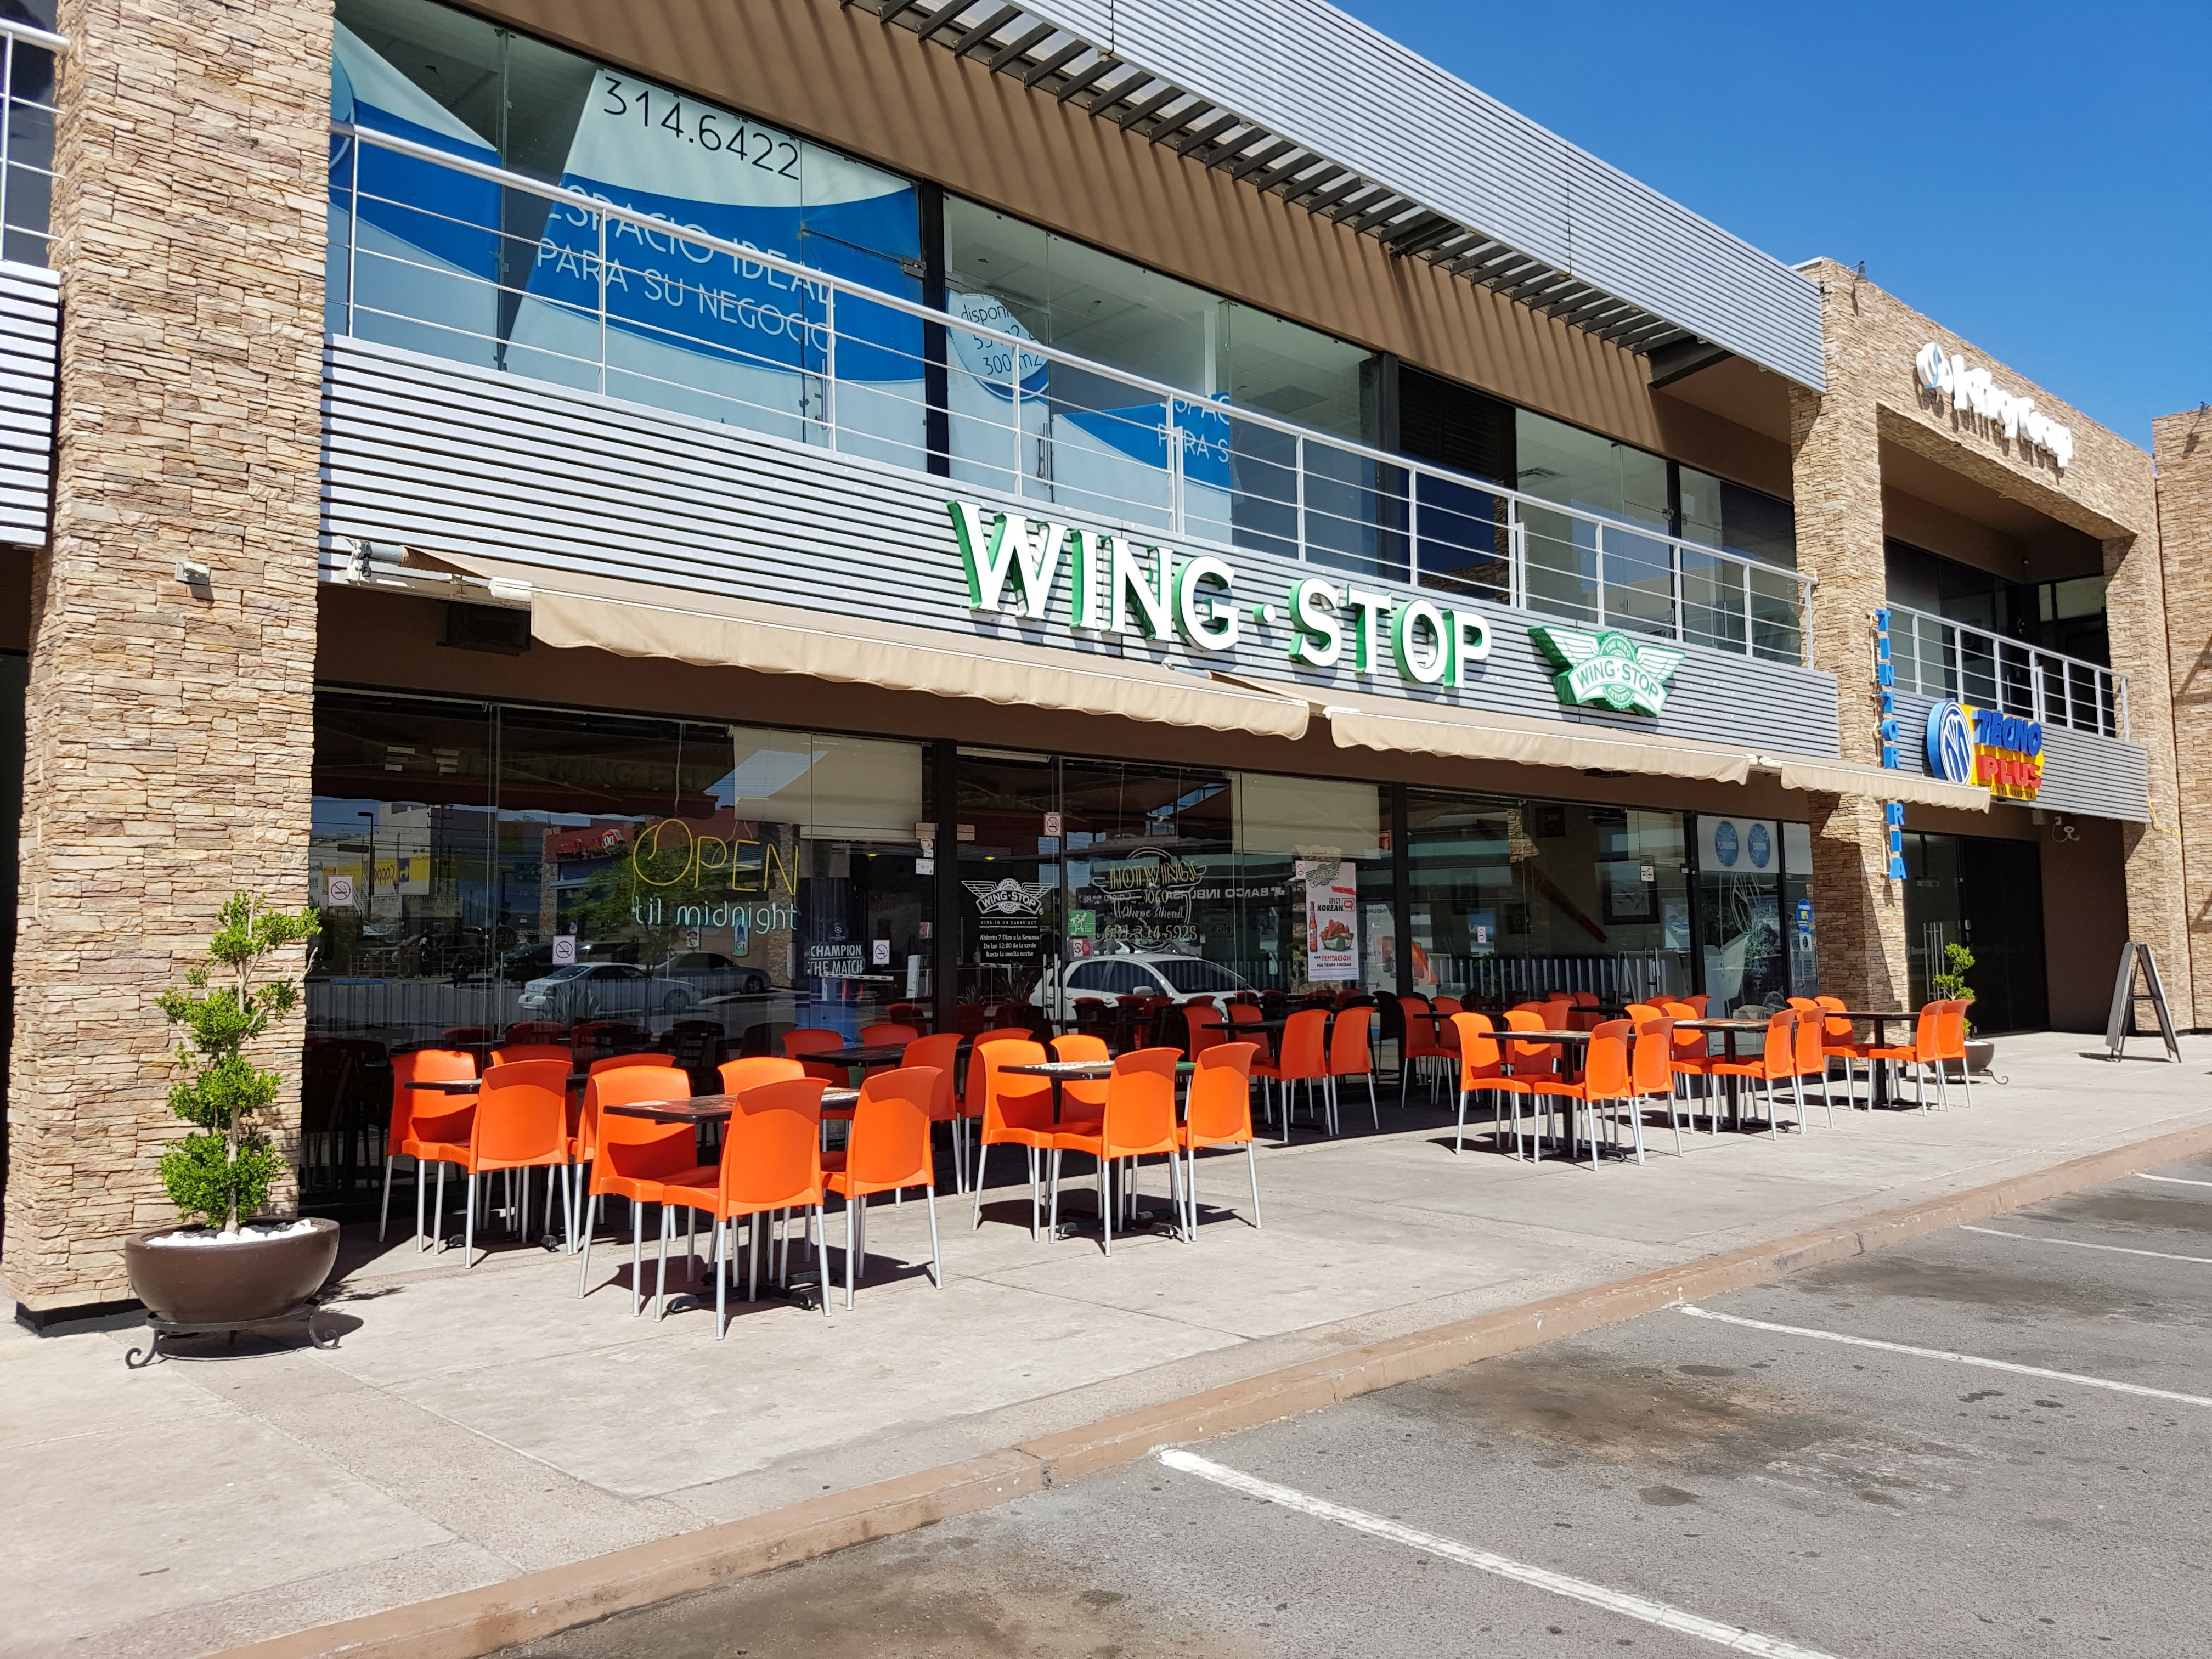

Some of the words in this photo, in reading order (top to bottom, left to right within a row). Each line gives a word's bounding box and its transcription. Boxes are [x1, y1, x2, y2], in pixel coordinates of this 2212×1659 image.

[603, 76, 800, 181] 314.6422
[537, 236, 628, 292] PARA
[644, 268, 684, 307] SU
[698, 283, 836, 353] NEGOCIO
[983, 353, 1012, 375] 300
[1157, 422, 1210, 459] PRA
[947, 499, 1240, 652] WING
[1289, 577, 1492, 690] STOP
[1875, 608, 1908, 879] TINTORRIA
[1972, 709, 2042, 757] TECNO
[1976, 754, 2042, 789] PLUS
[633, 818, 799, 896] OPEN
[675, 900, 798, 934] midnight
[981, 891, 1008, 908] WING
[1011, 891, 1037, 907] STOP
[1317, 904, 1343, 912] KOREAN
[806, 960, 829, 975] THE
[832, 959, 862, 975] MATCH
[810, 944, 862, 957] CHAMPION
[1321, 953, 1352, 962] TENTACIÓN
